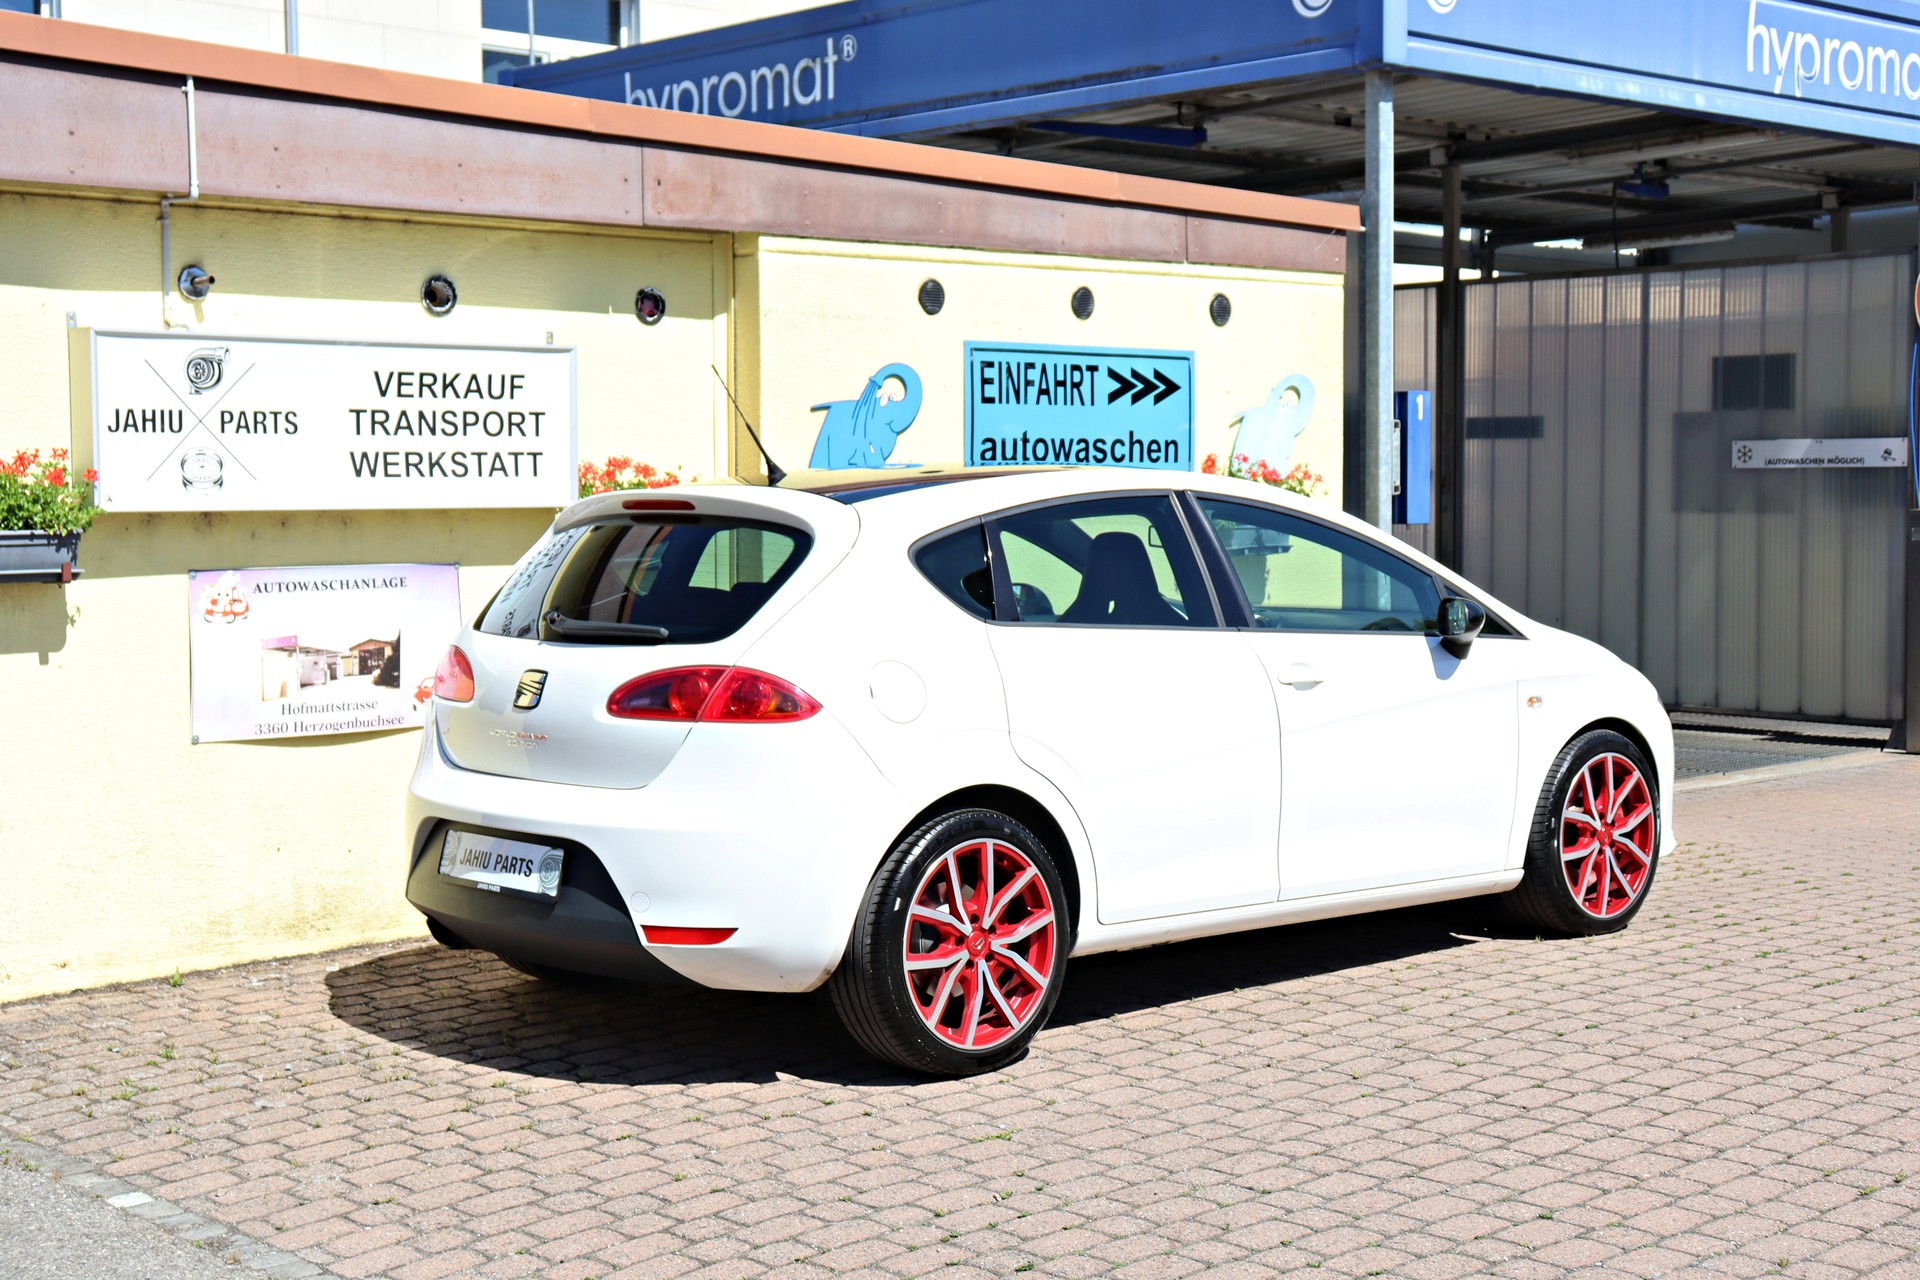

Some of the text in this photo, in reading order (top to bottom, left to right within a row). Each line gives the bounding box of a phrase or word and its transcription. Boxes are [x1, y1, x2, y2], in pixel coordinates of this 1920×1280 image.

[374, 371, 526, 400] VERKAUF
[980, 361, 1099, 406] EINFAHRT
[1416, 394, 1424, 421] 1
[107, 408, 299, 435] JAHIU PARTS
[348, 408, 546, 438] TRANSPORT
[980, 430, 1179, 463] autowaschen
[349, 451, 544, 478] WERKSTATT
[253, 576, 408, 594] AUTOWASCHANLAGE
[281, 699, 379, 716] Hofmattstrasse
[254, 715, 405, 736] 3360 Herzogenbuchsee
[460, 847, 534, 877] JAHIU PARTS
